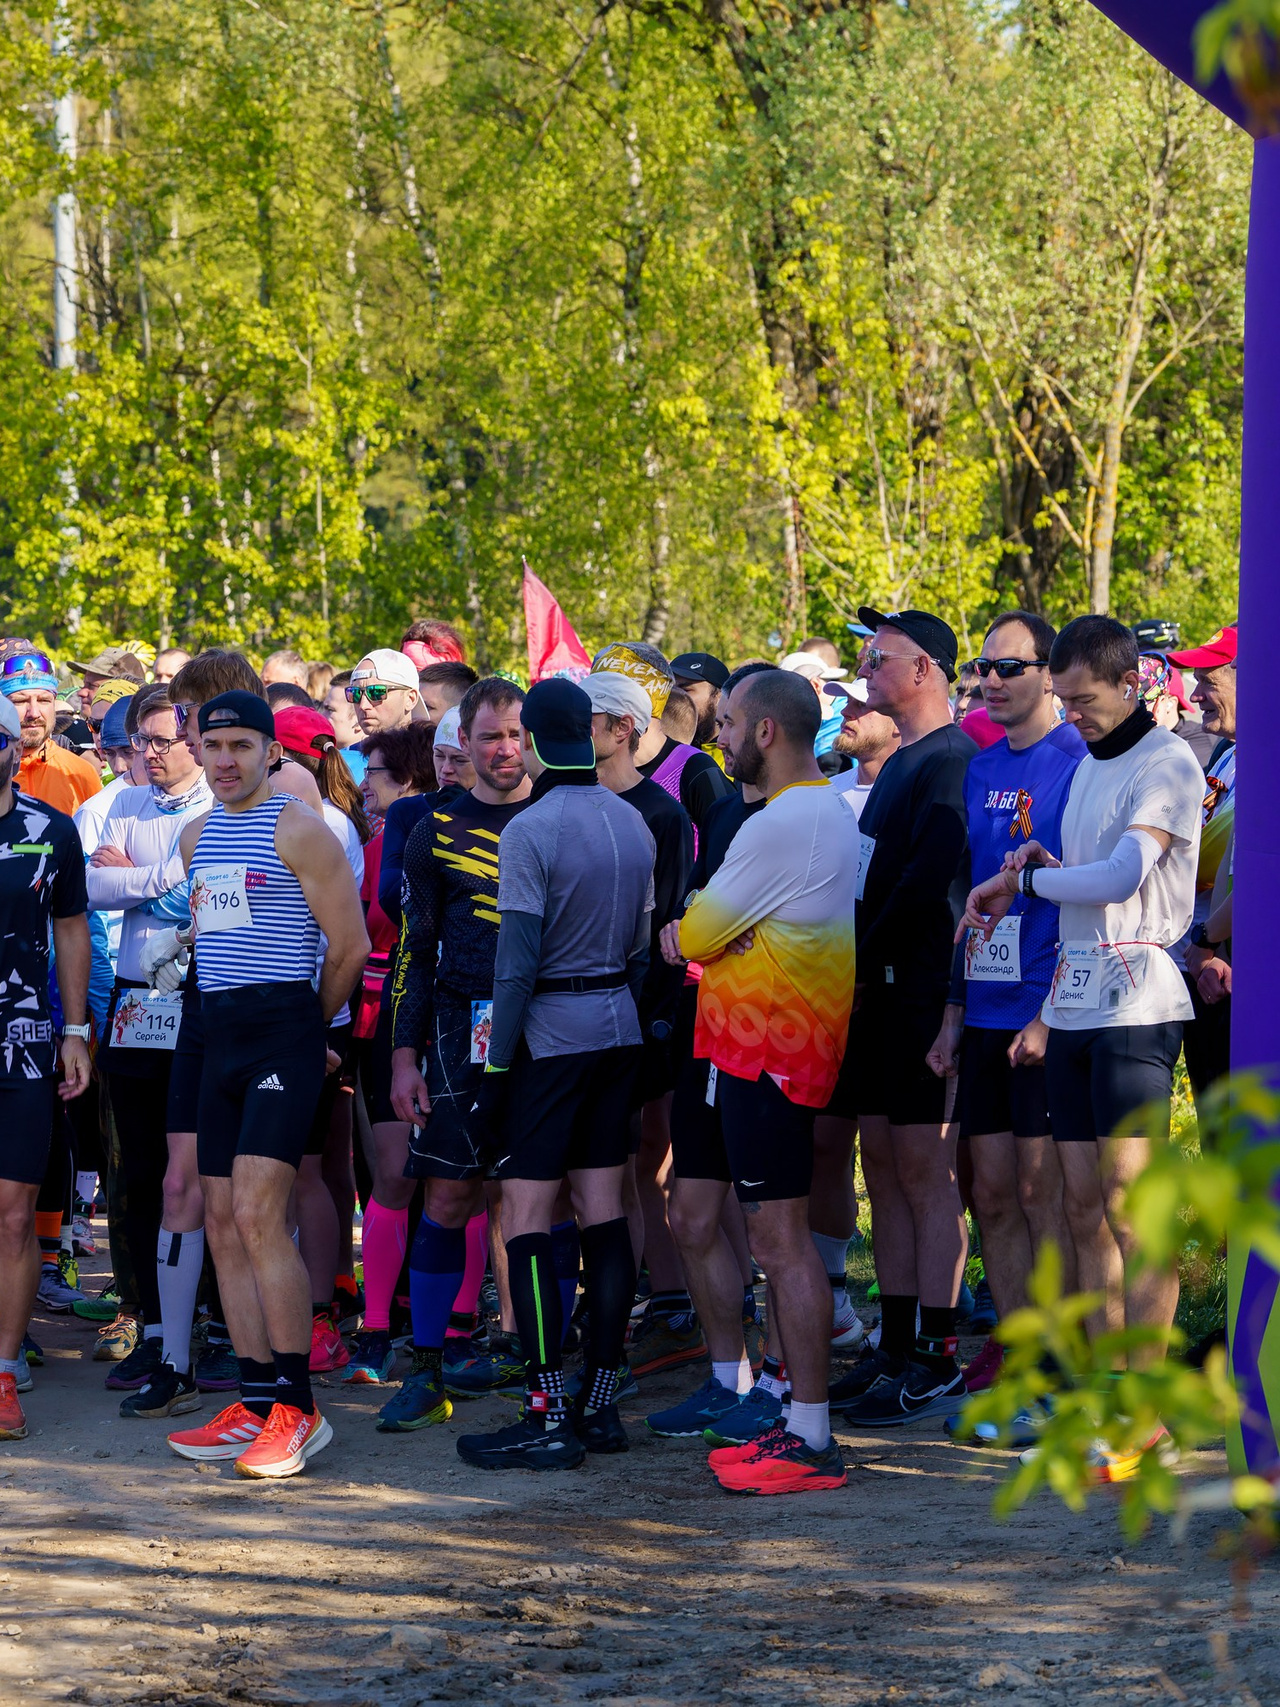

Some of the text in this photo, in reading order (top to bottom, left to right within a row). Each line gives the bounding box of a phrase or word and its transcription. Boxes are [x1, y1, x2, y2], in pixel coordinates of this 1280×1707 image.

[597, 657, 658, 678] NEVER
[985, 790, 1000, 809] ЗА
[210, 891, 240, 911] 196
[989, 944, 1009, 961] 90
[973, 963, 1014, 975] Александр
[1072, 969, 1091, 987] 57
[1060, 989, 1085, 1002] Денис
[147, 1014, 176, 1031] 114
[135, 1031, 167, 1043] Сергей
[257, 1083, 284, 1091] adidas
[286, 1416, 311, 1455] TERREX
